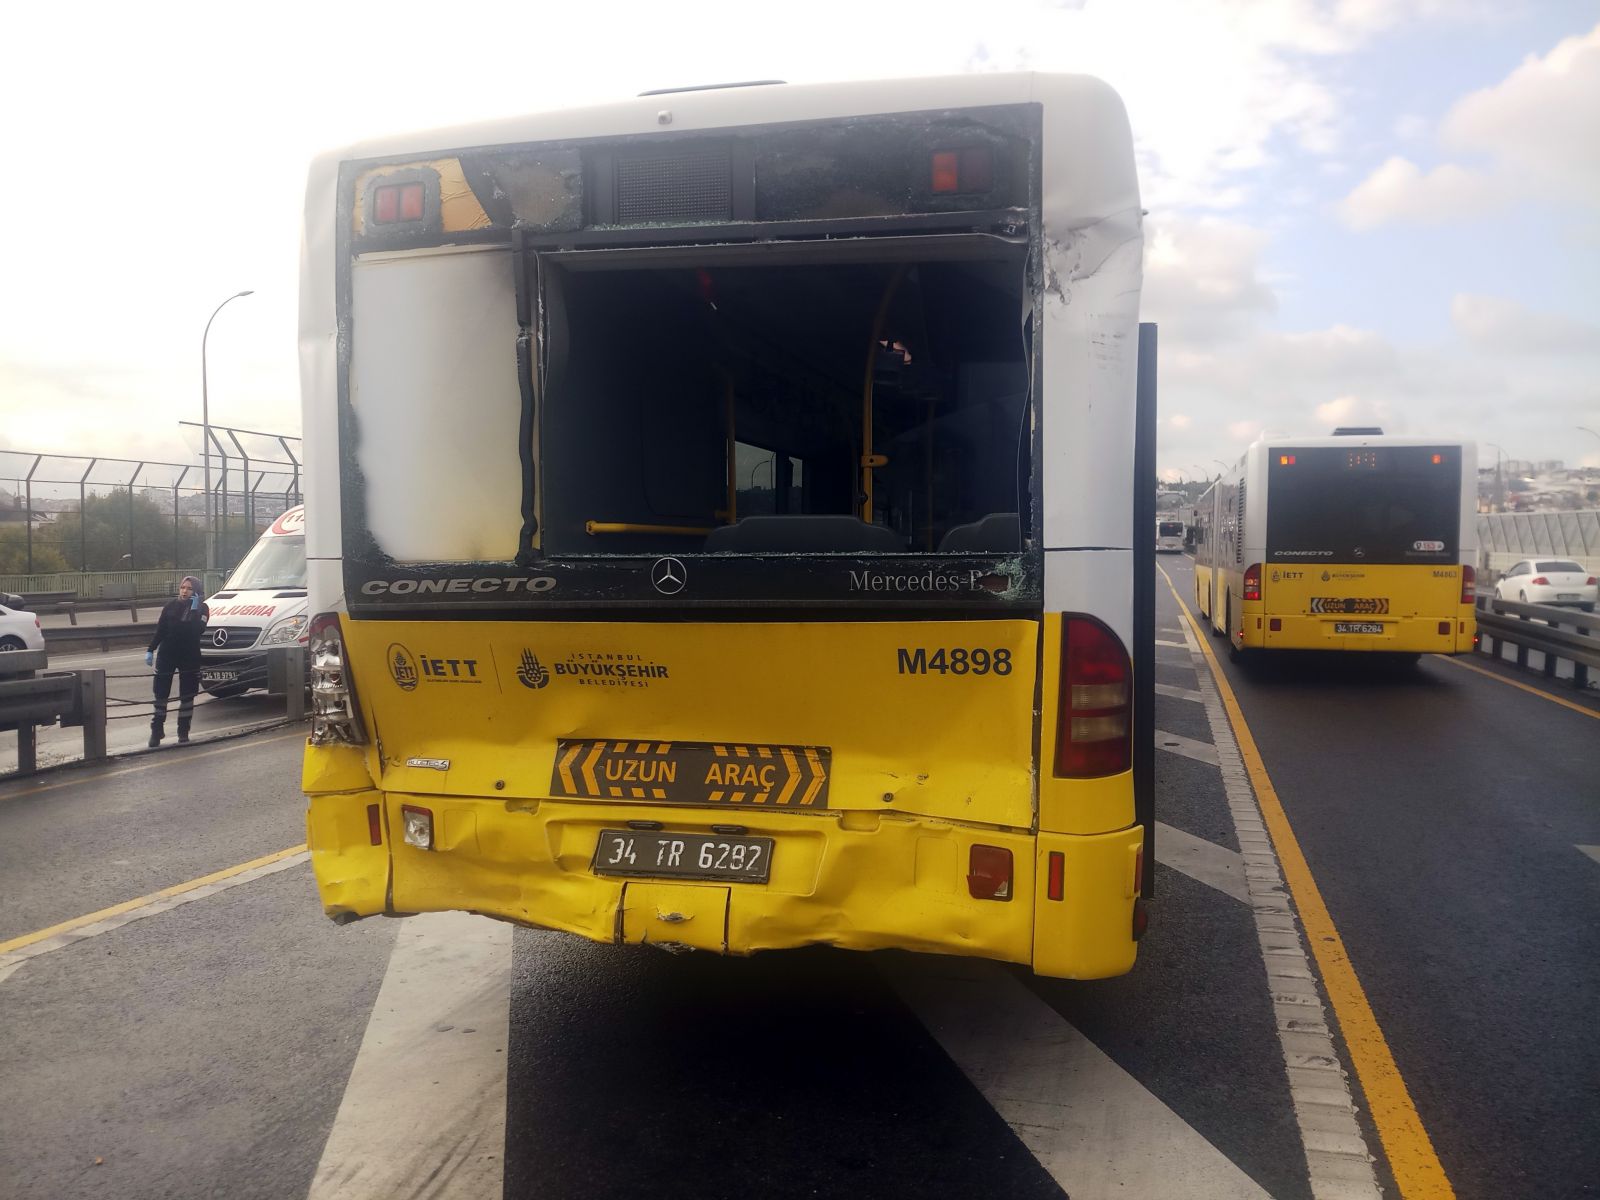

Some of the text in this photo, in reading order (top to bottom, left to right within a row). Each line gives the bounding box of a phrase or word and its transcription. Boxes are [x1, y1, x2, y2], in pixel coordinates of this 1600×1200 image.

[361, 577, 557, 596] CONECTO
[849, 570, 1028, 591] Mercedes-Bz
[419, 654, 478, 678] İETT
[554, 658, 669, 680] BÜYÜKŞEHİR
[897, 648, 1013, 676] M4898
[579, 678, 650, 689] BELEDİYESİ
[605, 758, 776, 793] UZUN ARAÇ
[608, 837, 637, 865] 34
[656, 840, 686, 867] TR
